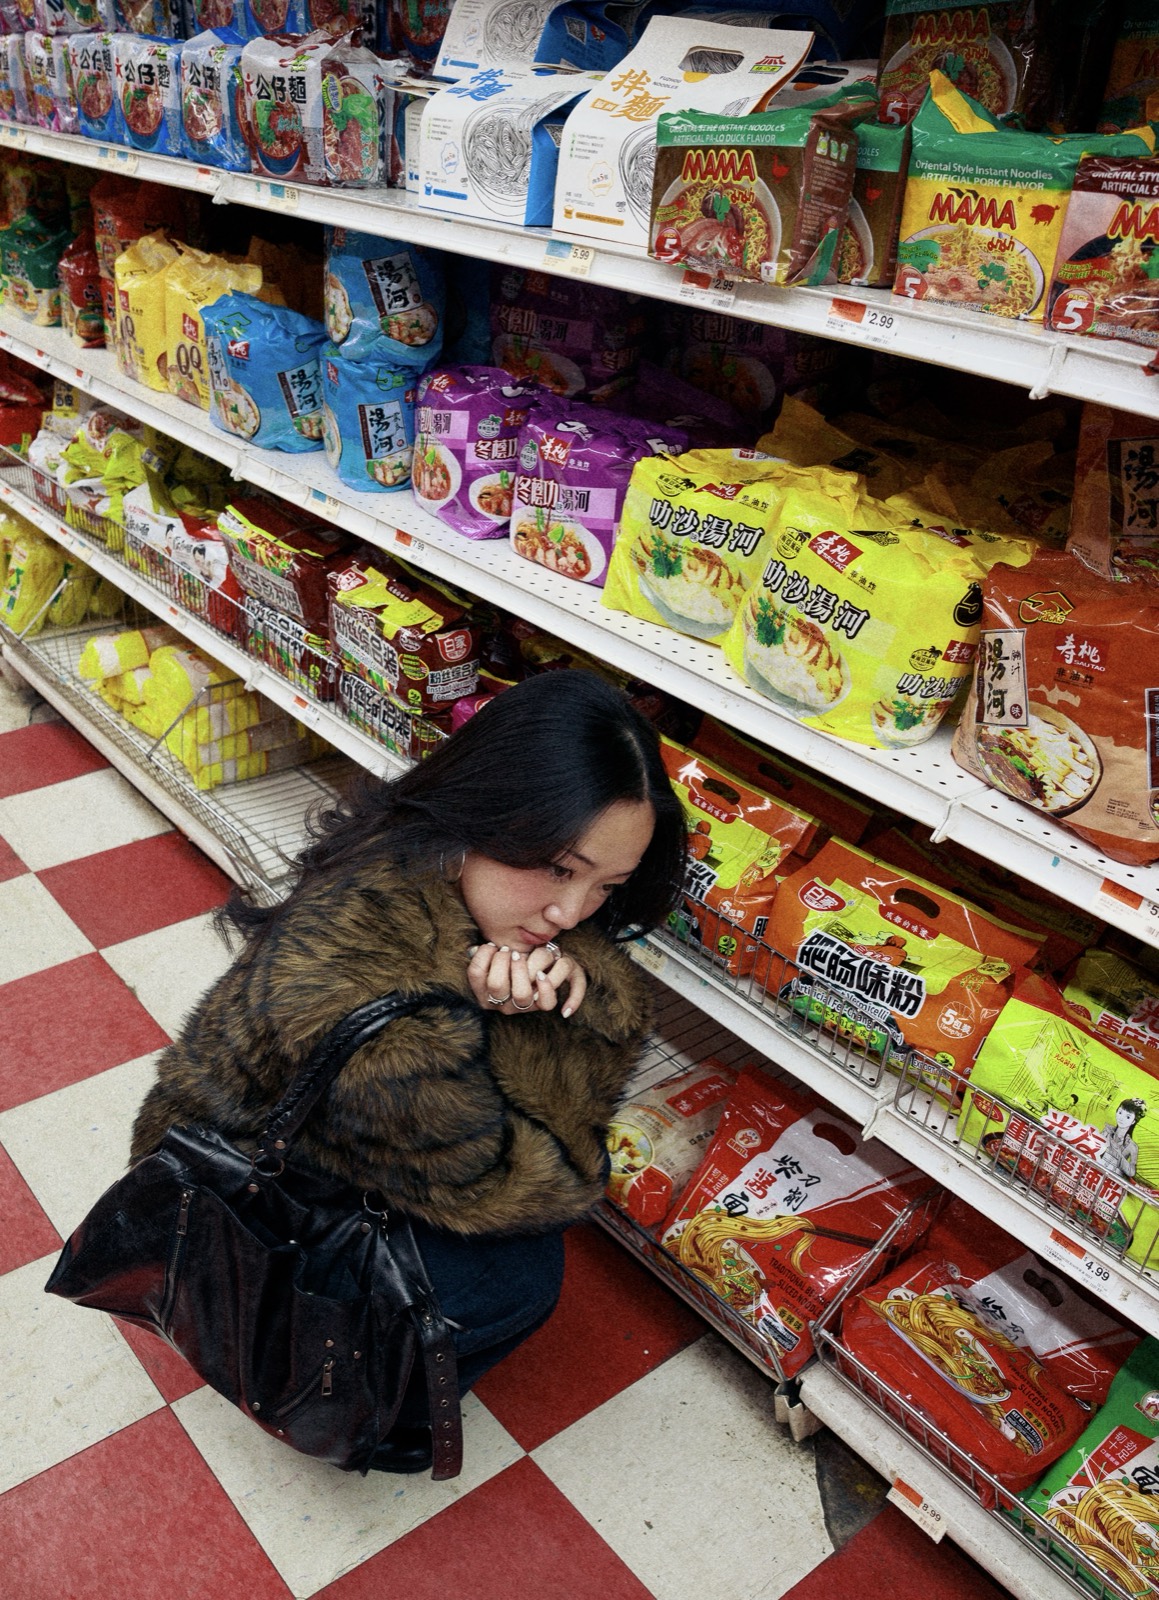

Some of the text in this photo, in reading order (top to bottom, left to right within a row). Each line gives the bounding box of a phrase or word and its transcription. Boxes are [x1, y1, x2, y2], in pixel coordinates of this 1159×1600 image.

[910, 8, 991, 48] MAMA
[124, 58, 170, 88] 公仔麵
[653, 82, 680, 90] NOODLES
[256, 73, 307, 104] 公仔麵
[673, 134, 776, 144] ARTIFICIAL PA-LO DUCK FLAVOR
[717, 124, 746, 133] INSTANT
[682, 149, 757, 183] MAMA
[915, 160, 1053, 186] Oriental Style Instant Noodles
[920, 172, 1046, 197] ARTIFICIAL PORK FLAVOR
[1101, 182, 1149, 197] ARTIFICIAL
[928, 191, 1017, 231] MAMA
[1056, 300, 1088, 330] 5
[649, 497, 766, 557] 叻沙湯河
[761, 558, 870, 644] 叻沙湯河
[1056, 633, 1101, 665] 寿桃
[1055, 667, 1095, 686] 非油炸
[1073, 659, 1106, 672] SAUTAO
[1009, 703, 1023, 720] 味
[805, 885, 840, 911] 白家
[798, 932, 925, 1018] 肥肠味粉
[768, 1257, 806, 1293] TRADITIONAL
[1083, 1255, 1111, 1282] $4.99
[776, 1277, 824, 1319] SLICED NOODLE
[1017, 1383, 1043, 1408] SLICED
[922, 1503, 942, 1522] 8.99
